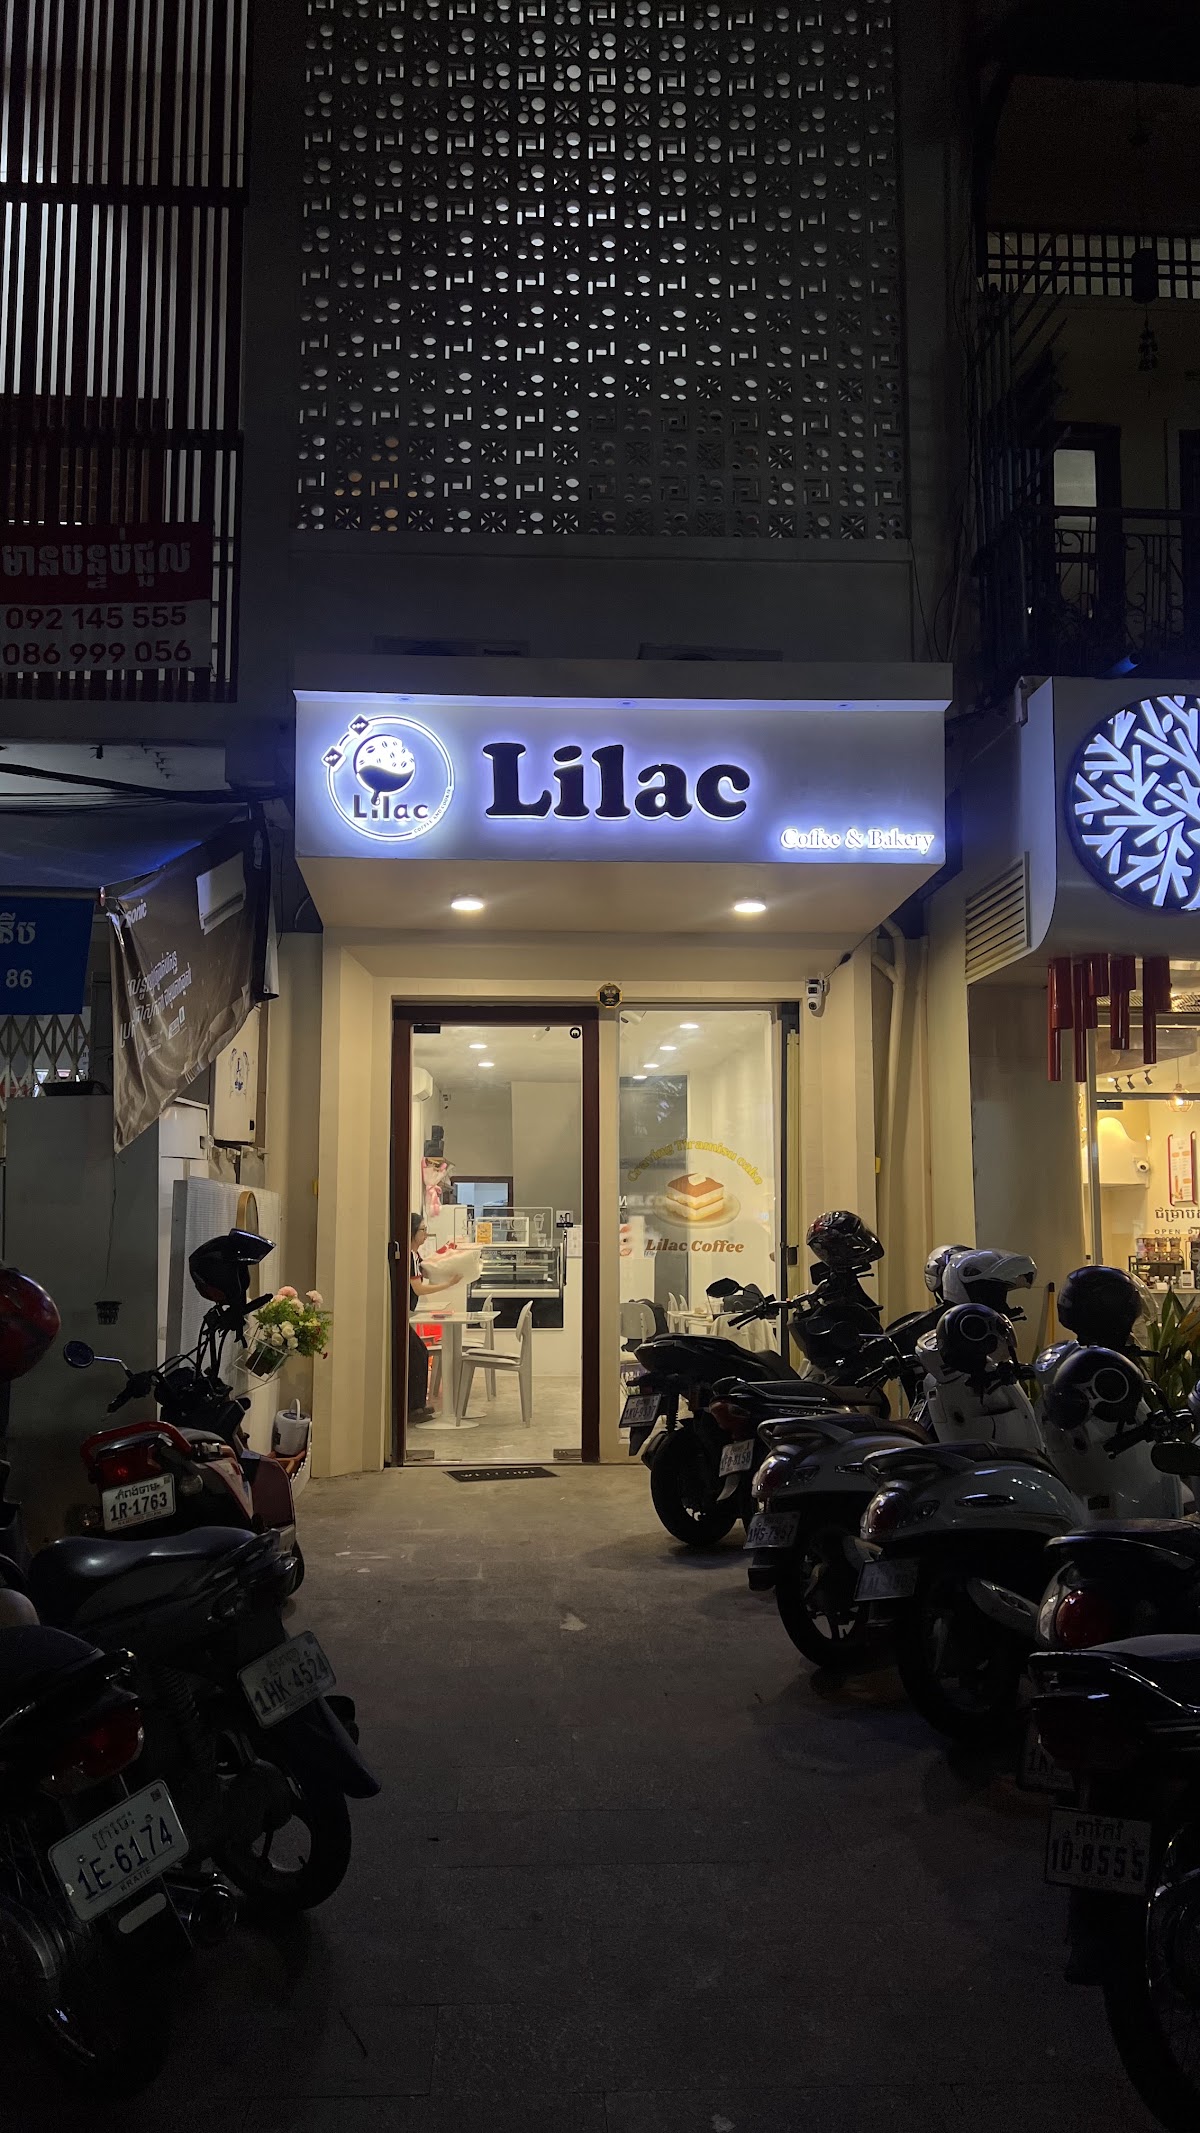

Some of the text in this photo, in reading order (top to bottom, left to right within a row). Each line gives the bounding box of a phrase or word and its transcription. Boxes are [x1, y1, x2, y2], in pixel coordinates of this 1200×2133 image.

[6, 605, 187, 630] 092 145 555
[2, 639, 192, 666] 086 999 056
[481, 742, 752, 821] Lilac
[353, 794, 429, 820] Lilac
[781, 827, 935, 855] Coffee & Bakery
[6, 968, 33, 989] 86
[627, 1144, 674, 1182] Craving
[673, 1138, 738, 1161] Tiramisu
[645, 1238, 744, 1253] Lilac Coffee
[109, 1491, 168, 1522] 1R-1763
[78, 1817, 173, 1900] 1E-6174
